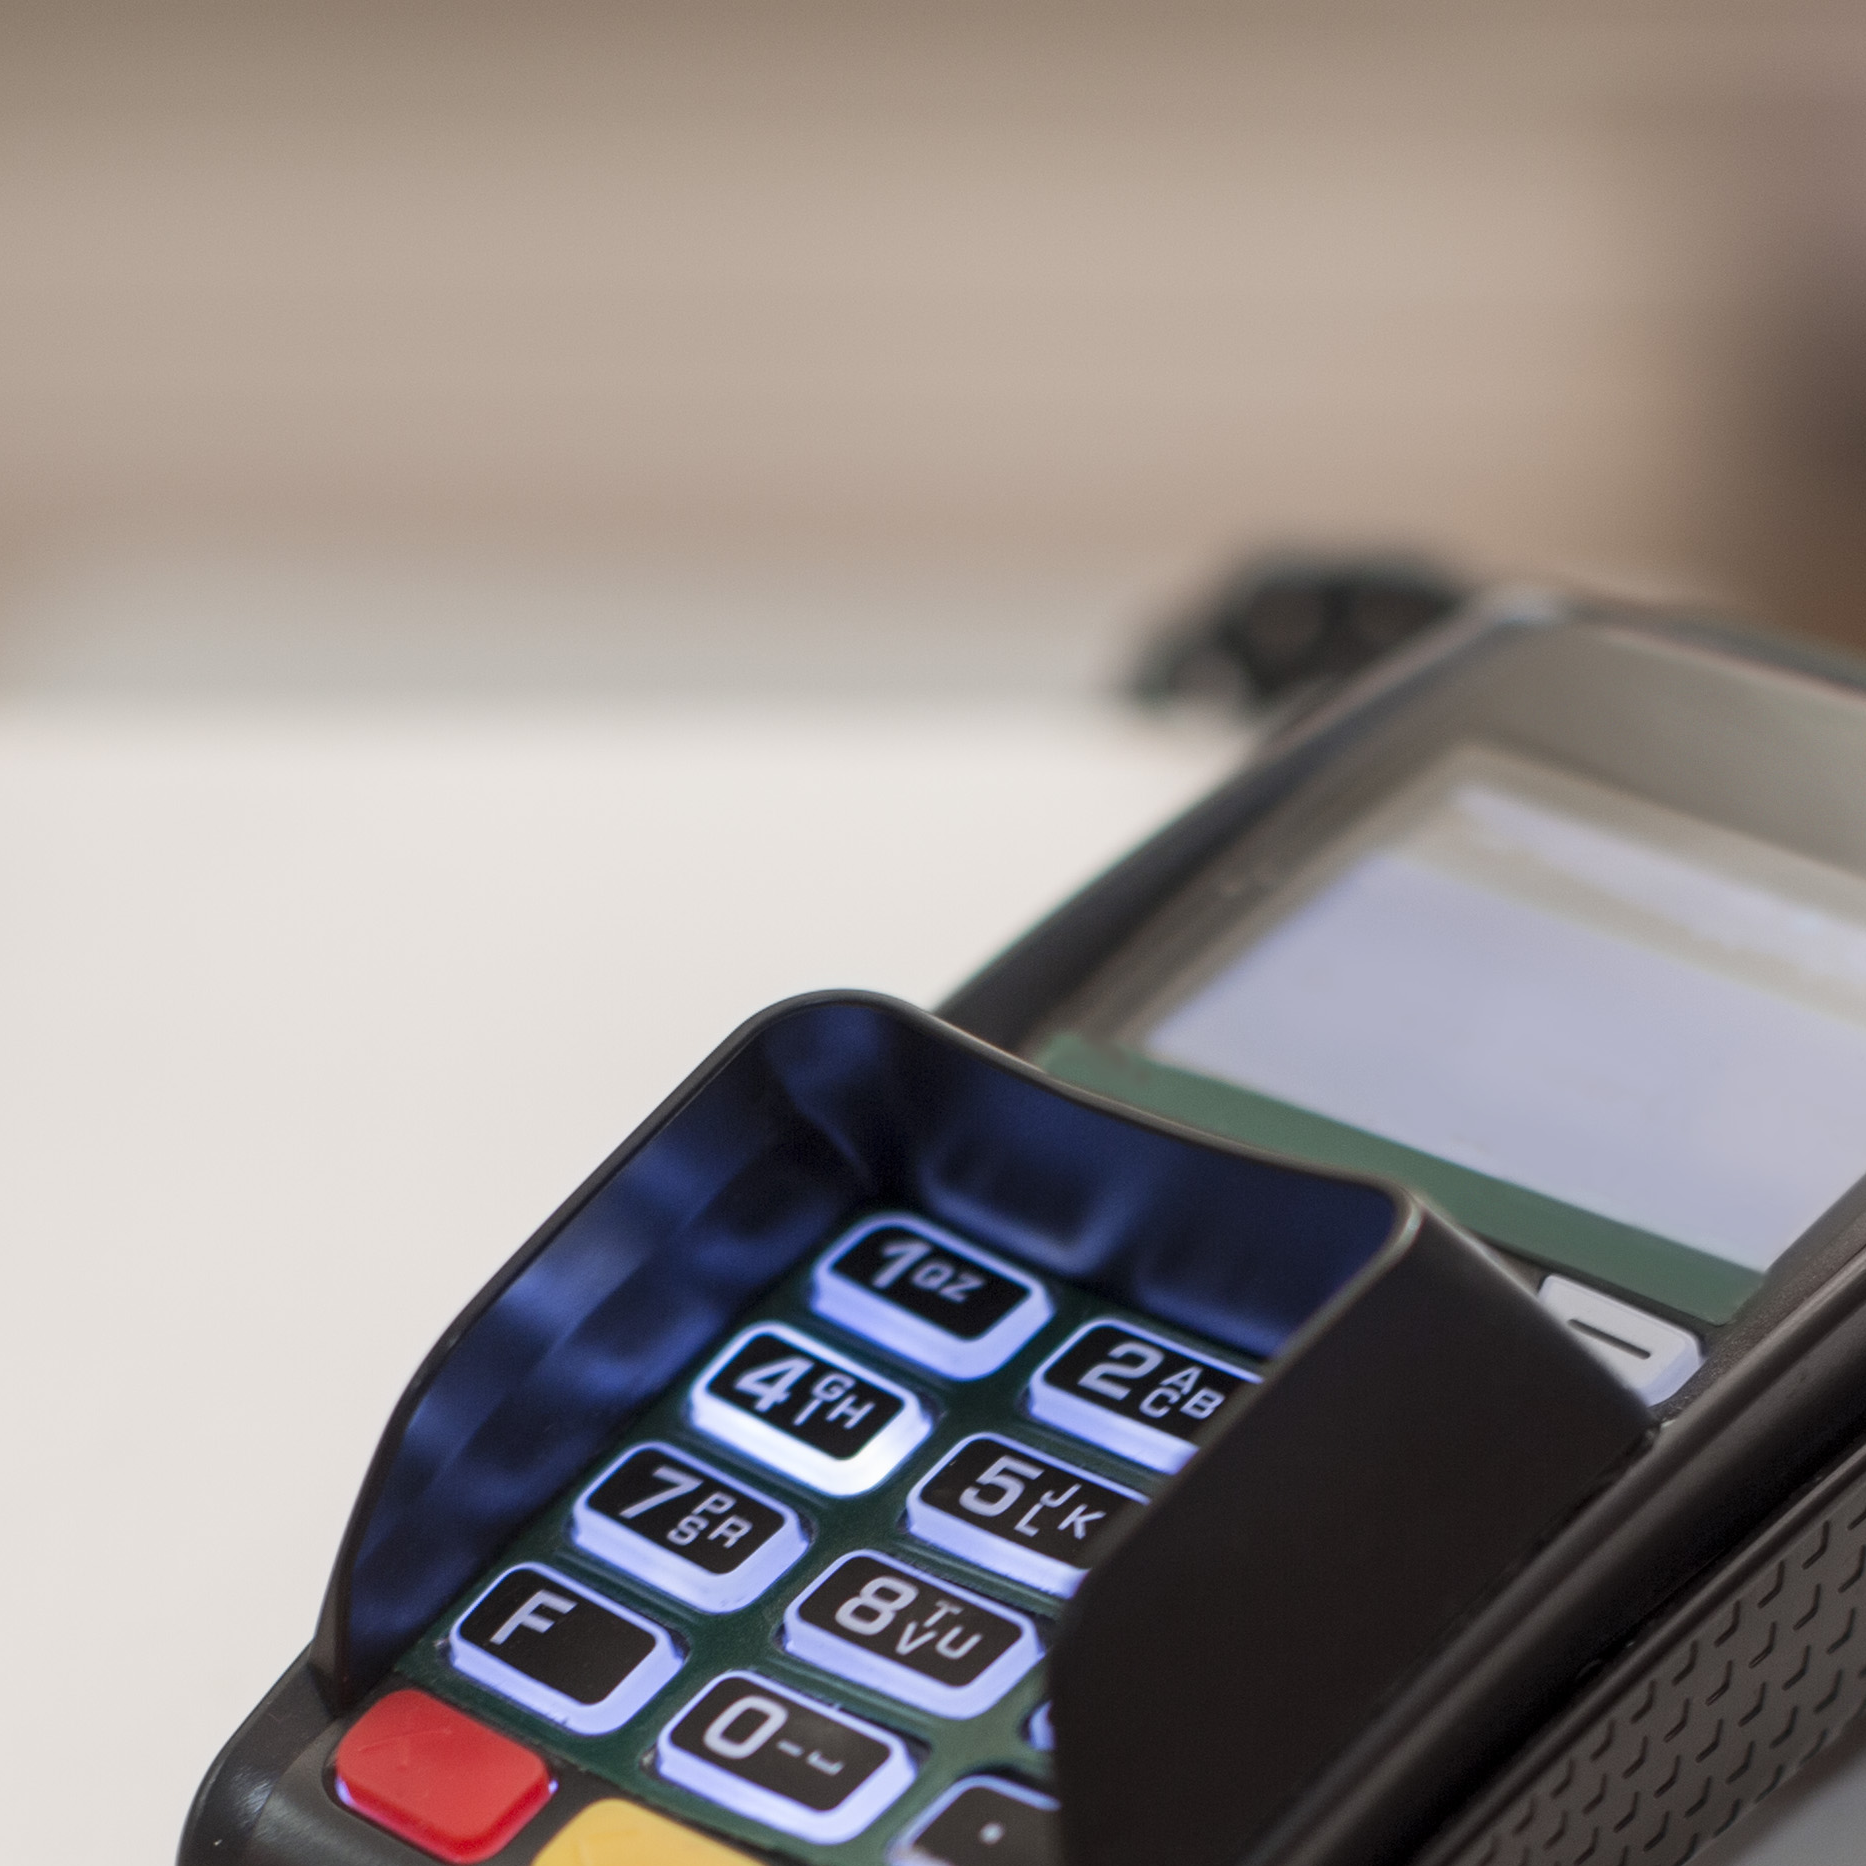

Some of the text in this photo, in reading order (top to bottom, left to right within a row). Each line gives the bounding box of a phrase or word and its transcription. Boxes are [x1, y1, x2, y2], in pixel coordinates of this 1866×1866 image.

[734, 1355, 815, 1413] 4
[1077, 1341, 1164, 1400] 2
[619, 1465, 703, 1519] 7
[958, 1454, 1044, 1516] 5
[490, 1589, 577, 1645] F
[835, 1575, 919, 1636] 8
